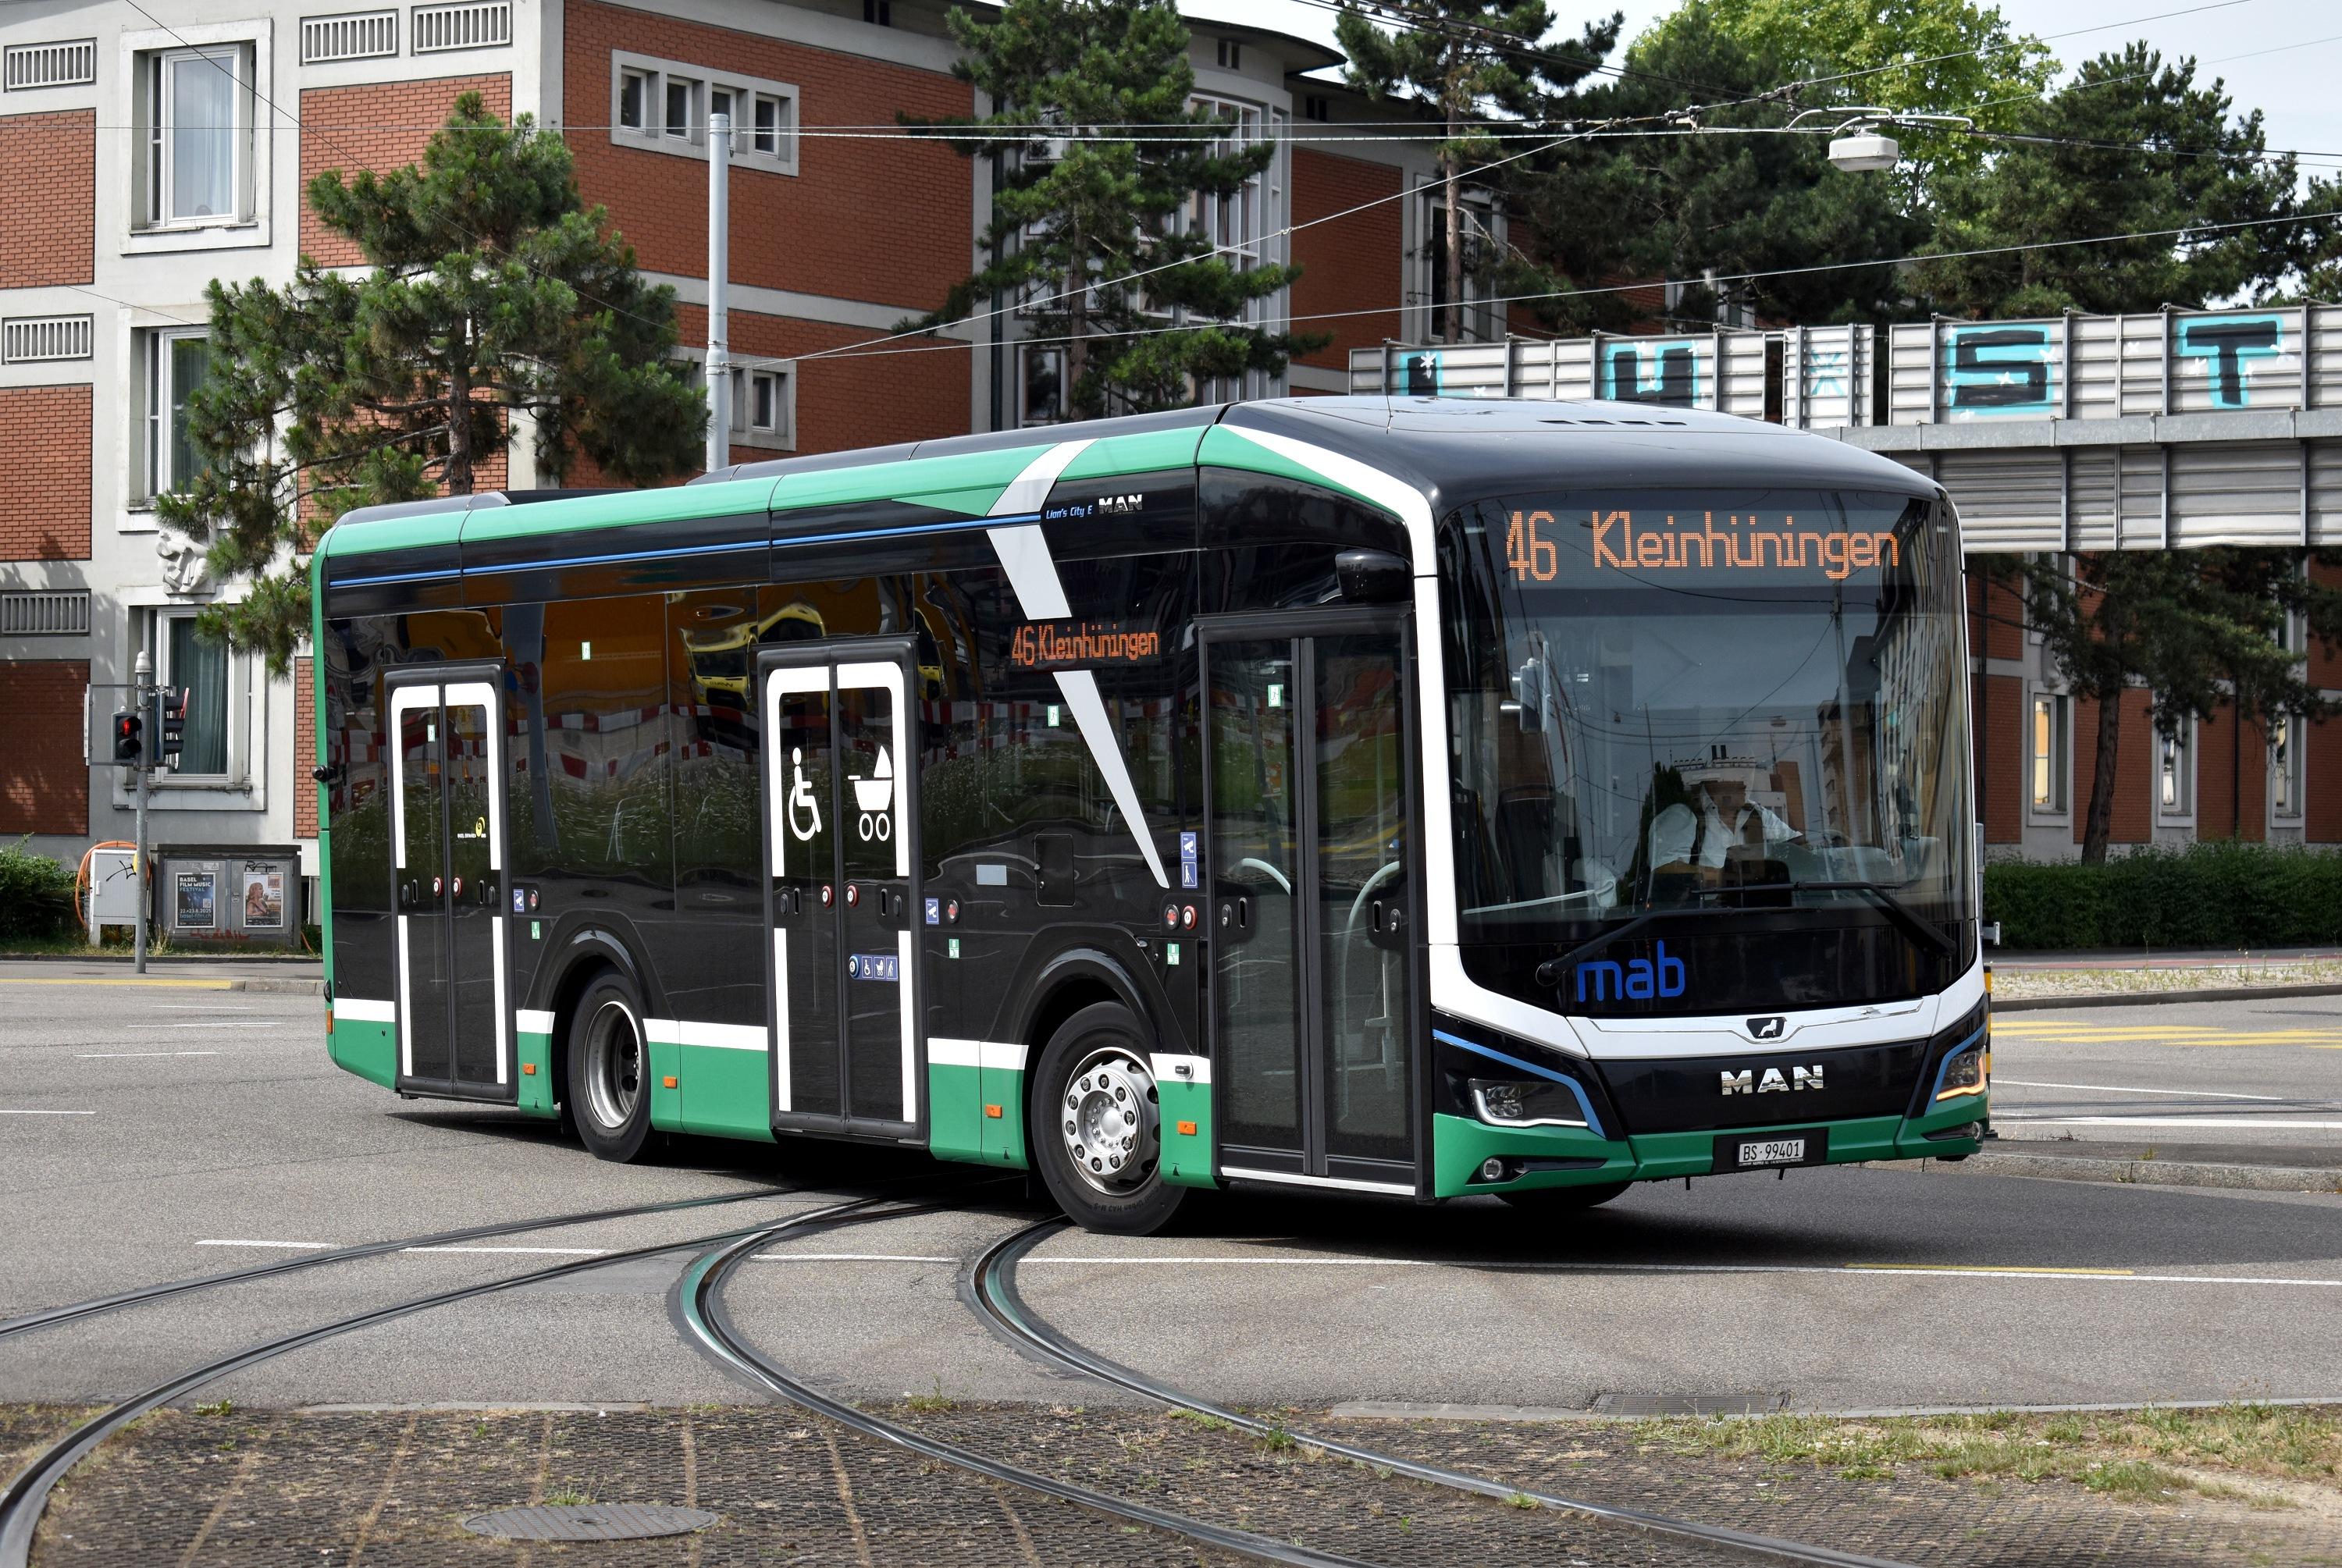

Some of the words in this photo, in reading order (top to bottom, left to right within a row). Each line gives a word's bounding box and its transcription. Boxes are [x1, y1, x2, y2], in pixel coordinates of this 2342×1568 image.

[1046, 508, 1067, 520] Lion's
[1070, 506, 1084, 517] City
[1087, 505, 1093, 515] E
[1098, 494, 1143, 514] MAN
[1507, 511, 1557, 581] 46
[1592, 511, 1899, 579] Kleinhüningen
[1011, 625, 1035, 666] 46
[1038, 622, 1159, 660] Kleinhüningen
[1577, 940, 1685, 1003] mab
[1721, 1065, 1824, 1096] MAN
